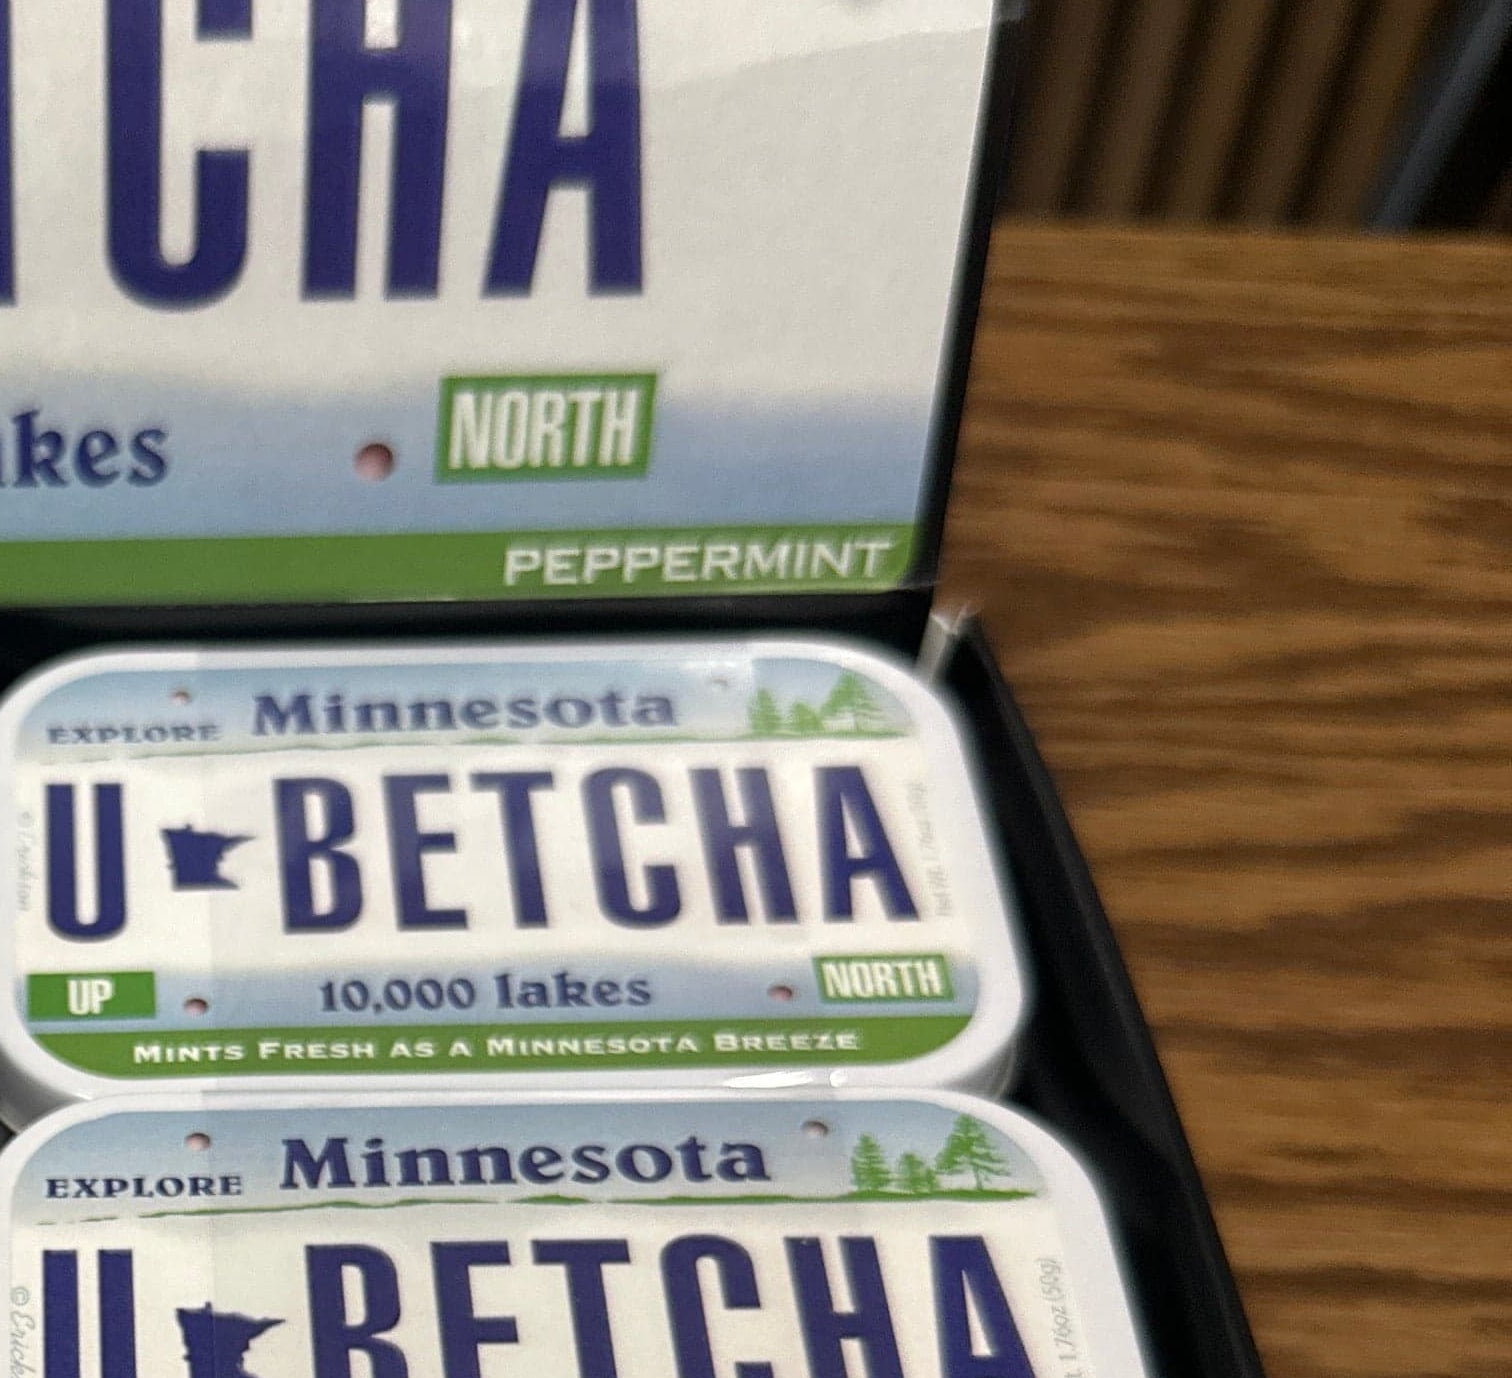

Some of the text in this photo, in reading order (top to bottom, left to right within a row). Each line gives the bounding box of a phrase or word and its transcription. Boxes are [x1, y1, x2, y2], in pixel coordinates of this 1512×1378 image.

[448, 386, 640, 472] NORTH
[503, 534, 895, 587] PEPPERMINT
[48, 691, 677, 744] EXPLORE Minnesota
[44, 782, 127, 943] U
[273, 766, 919, 934] BETCHA
[67, 978, 113, 1014] UP
[320, 973, 652, 1015] 10,000 lakes
[822, 961, 944, 998] NORTH
[45, 1136, 771, 1198] EXPLORE Minnesota
[1037, 1257, 1064, 1302] (50g)
[1052, 1305, 1077, 1361] 1.76oz
